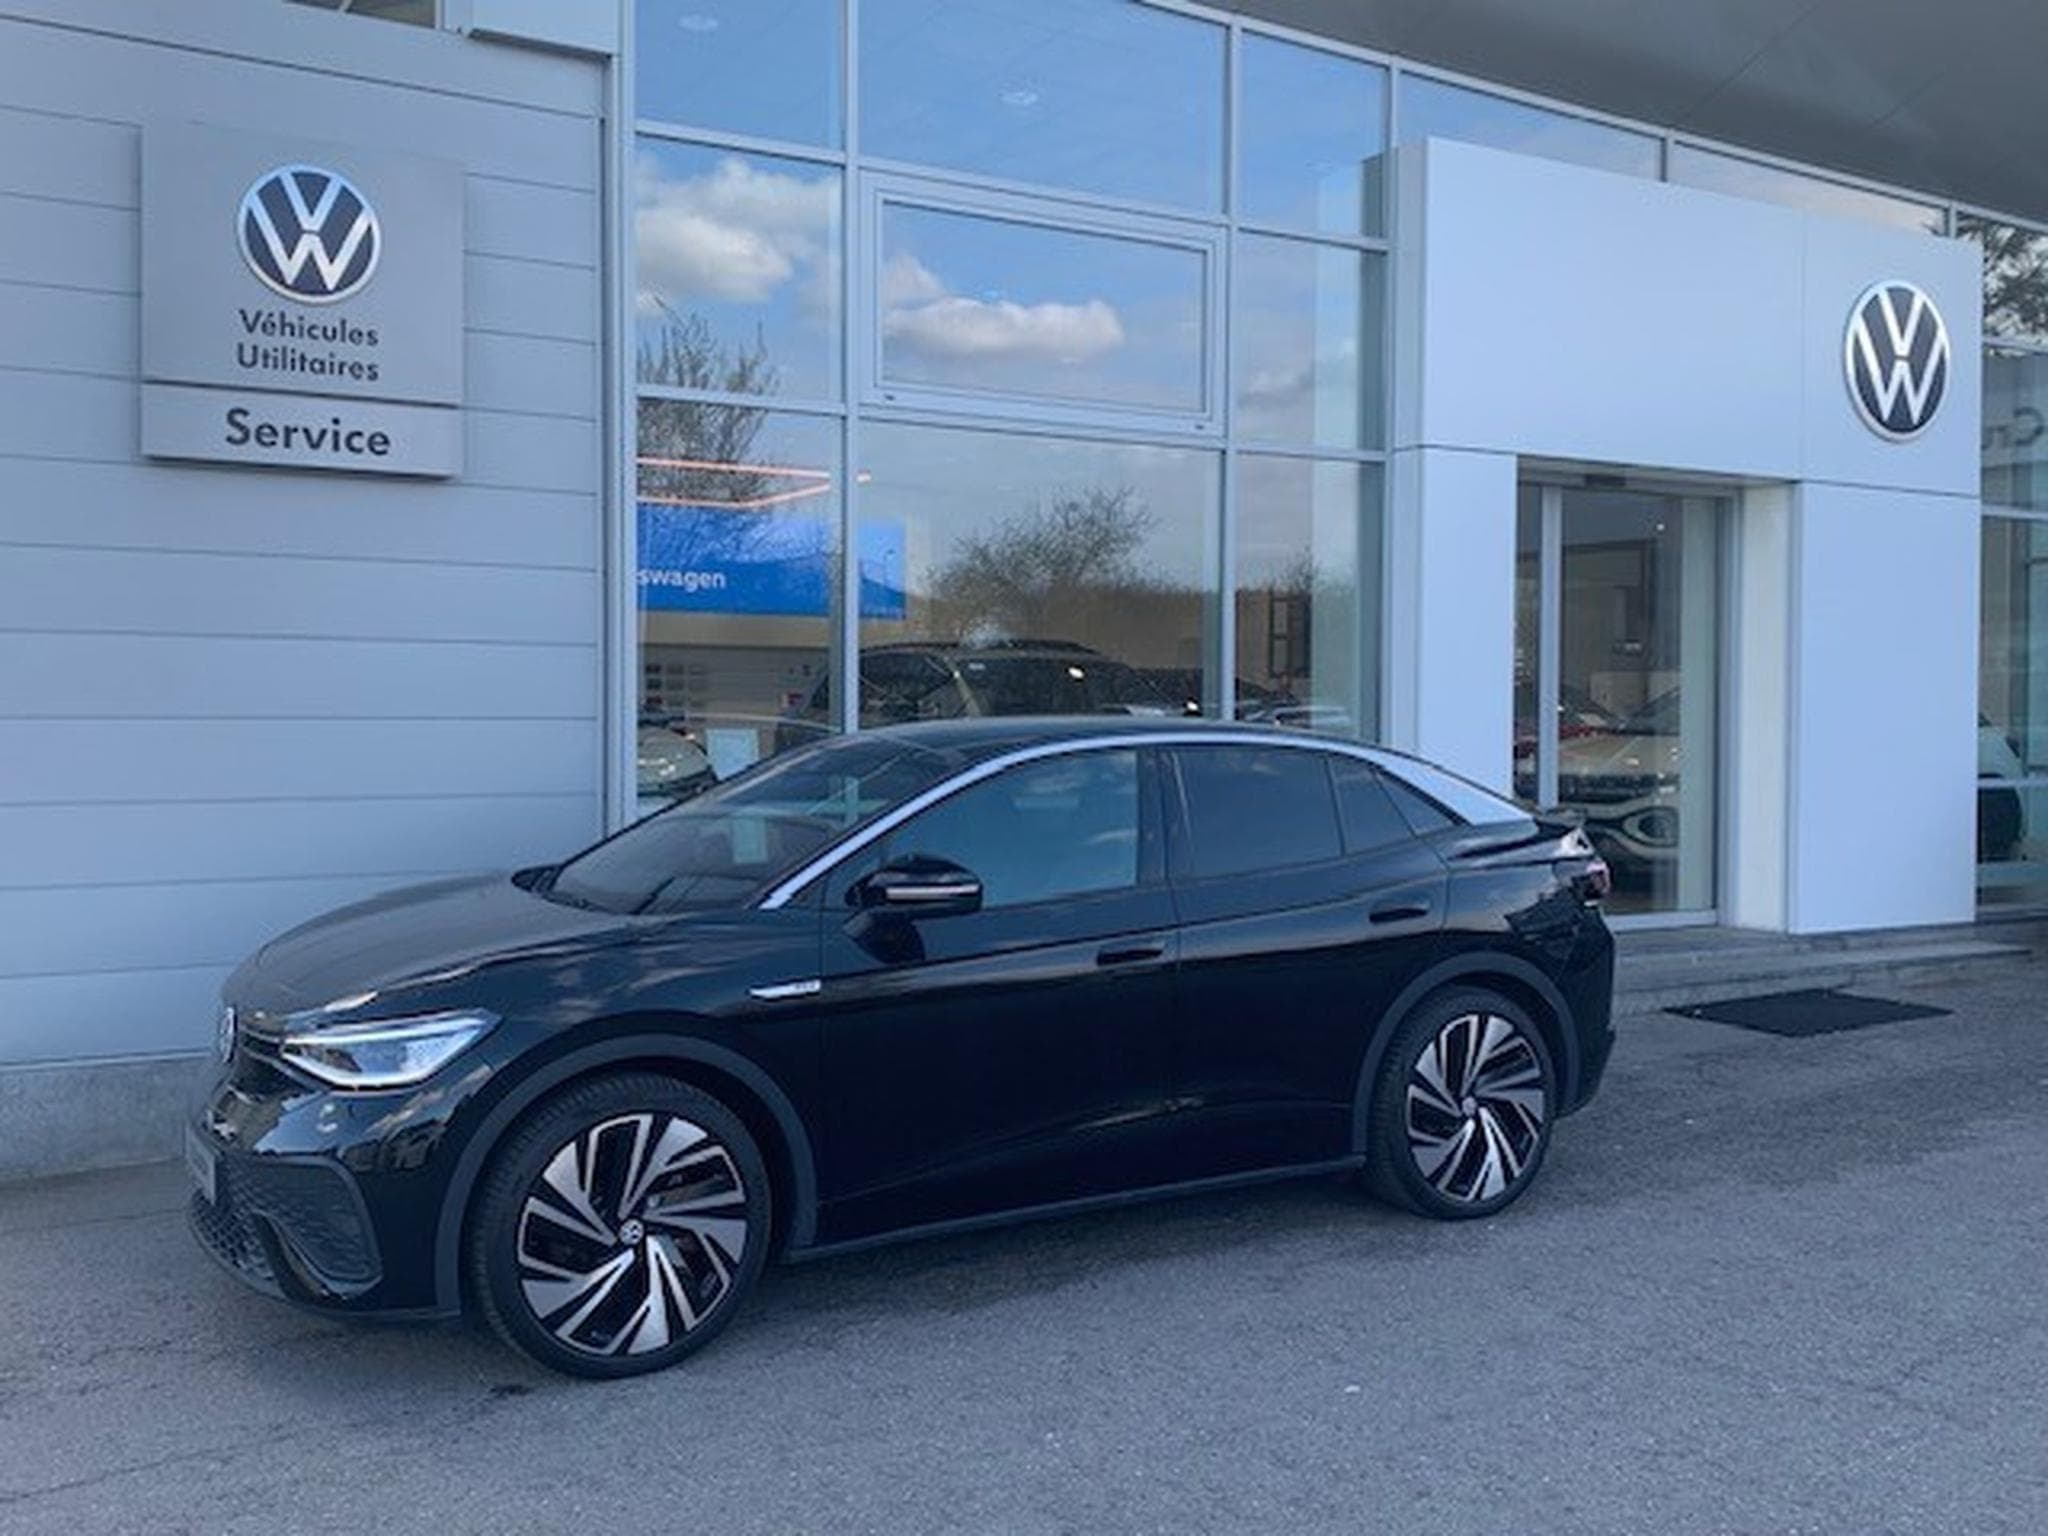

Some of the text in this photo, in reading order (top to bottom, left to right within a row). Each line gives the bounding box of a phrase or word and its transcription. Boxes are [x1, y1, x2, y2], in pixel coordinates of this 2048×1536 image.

[238, 308, 379, 346] Véhicules
[237, 342, 379, 382] Utilitaires
[225, 407, 391, 457] Service
